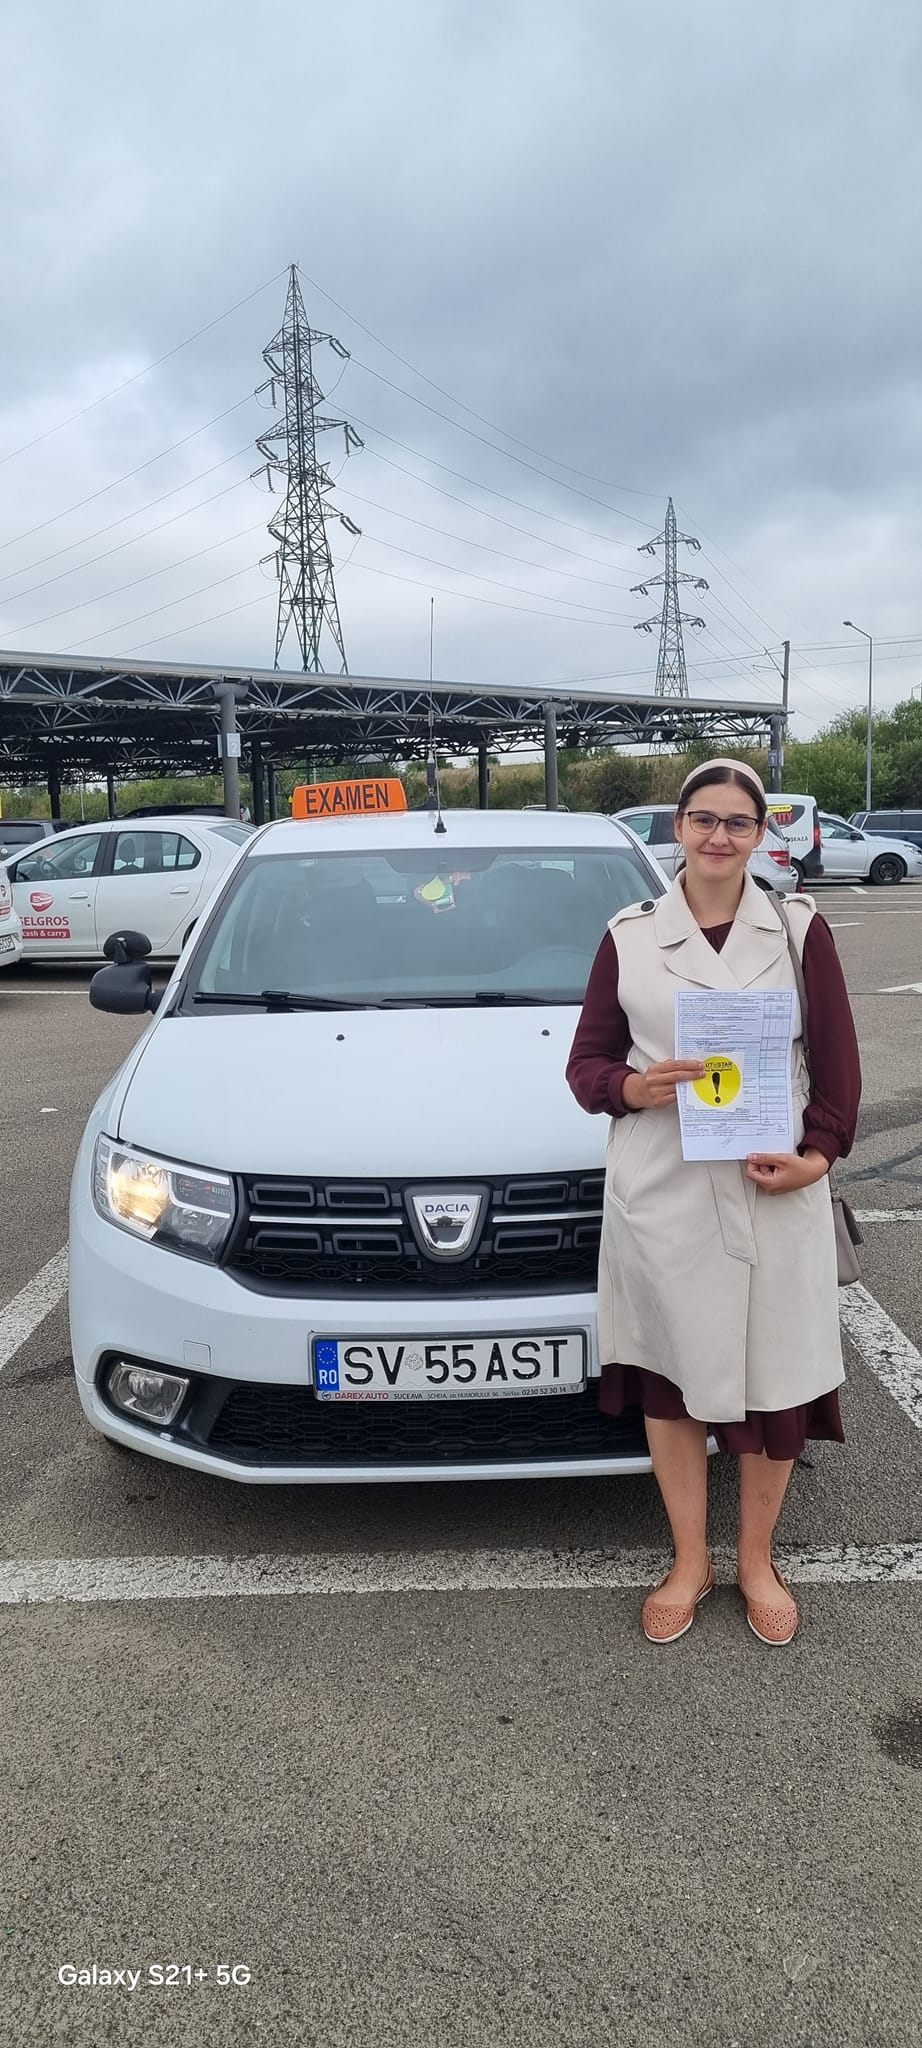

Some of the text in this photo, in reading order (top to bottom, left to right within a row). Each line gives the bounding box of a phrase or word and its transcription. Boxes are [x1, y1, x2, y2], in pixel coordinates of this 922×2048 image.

[231, 742, 238, 753] 2
[305, 783, 390, 815] EXAMEN
[47, 930, 67, 938] carry
[424, 1203, 470, 1213] DACIA
[344, 1339, 568, 1385] SV 55 AST
[319, 1369, 337, 1385] RO
[334, 1392, 363, 1400] DAREX
[364, 1392, 389, 1400] AUTO
[393, 1392, 423, 1400] SUCEAVA
[521, 1388, 539, 1396] 0230
[539, 1387, 548, 1395] 52
[549, 1386, 558, 1394] 30
